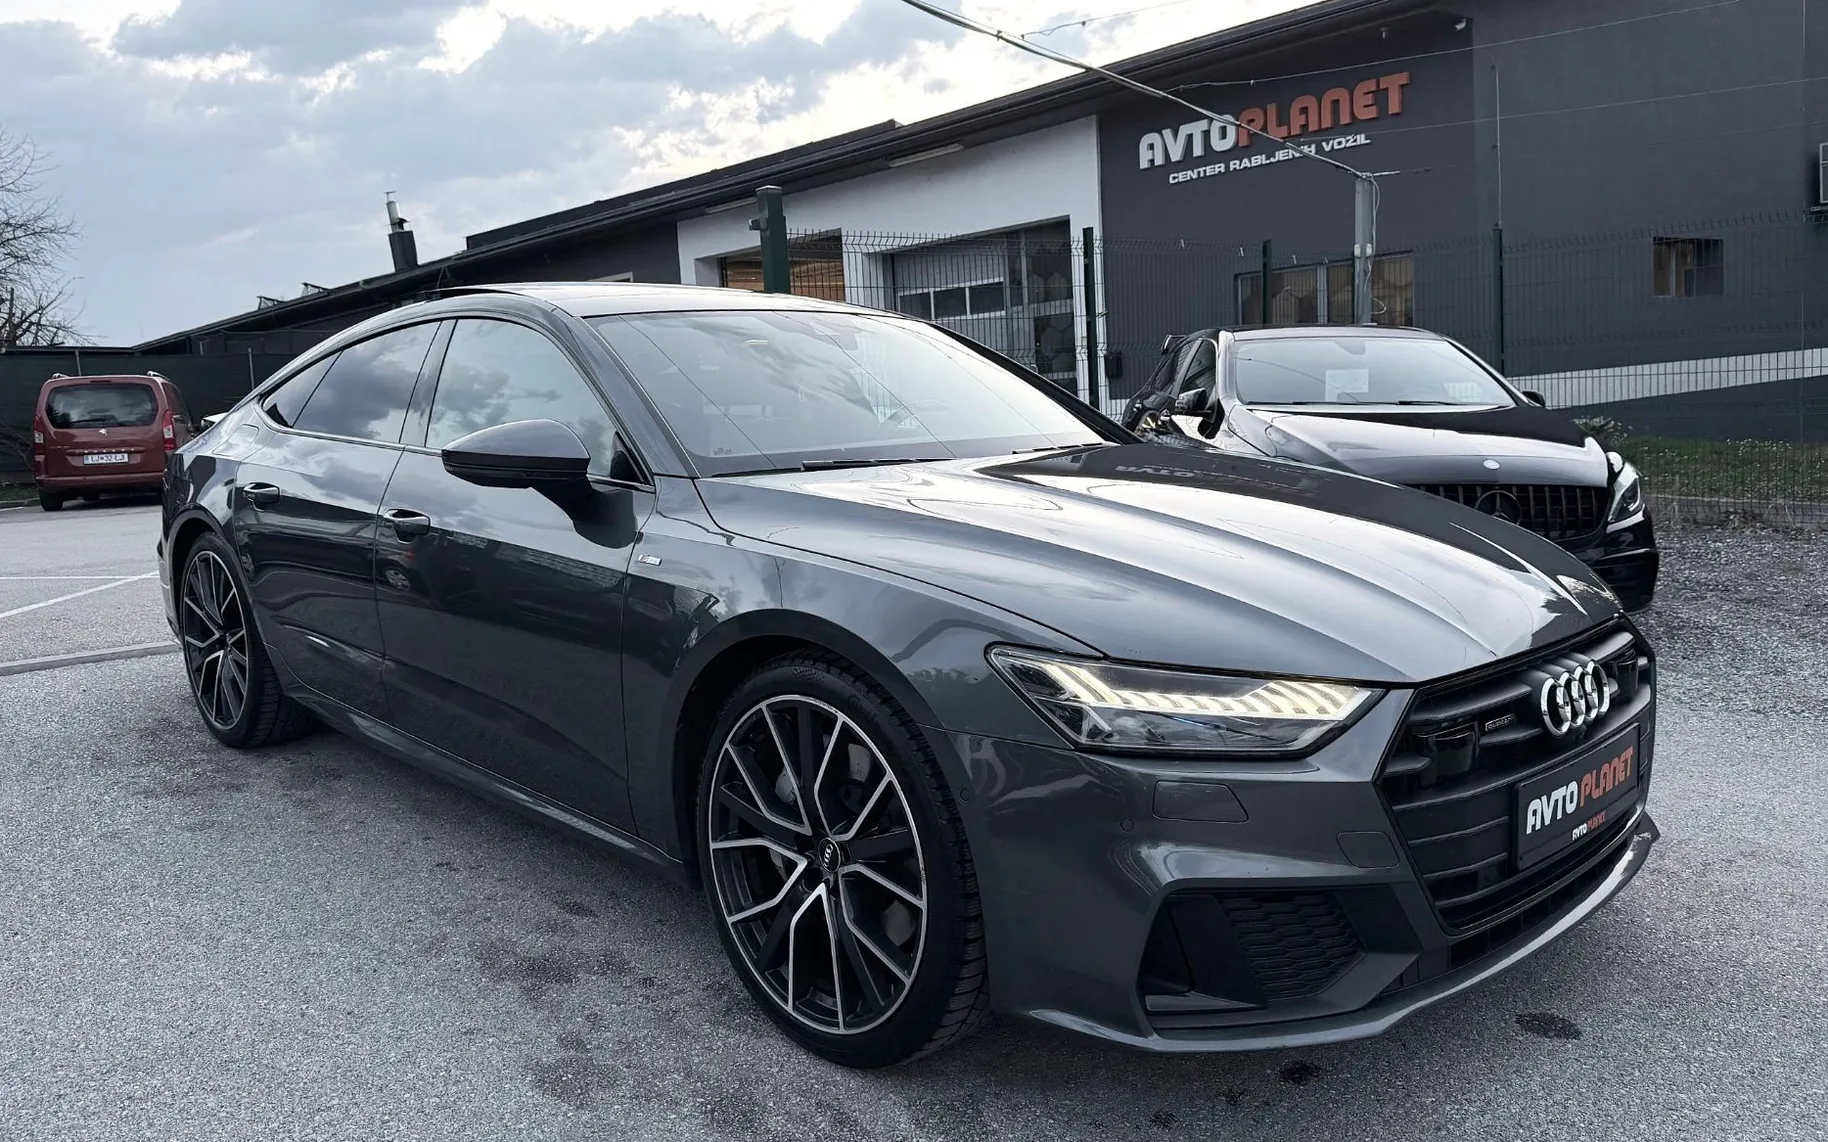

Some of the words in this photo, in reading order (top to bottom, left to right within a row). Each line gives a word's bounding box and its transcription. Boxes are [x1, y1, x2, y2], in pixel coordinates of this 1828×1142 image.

[1169, 164, 1225, 184] CENTER
[1322, 133, 1372, 152] VOŽIL
[1526, 780, 1579, 835] AVTO
[1580, 746, 1633, 807] PLANET
